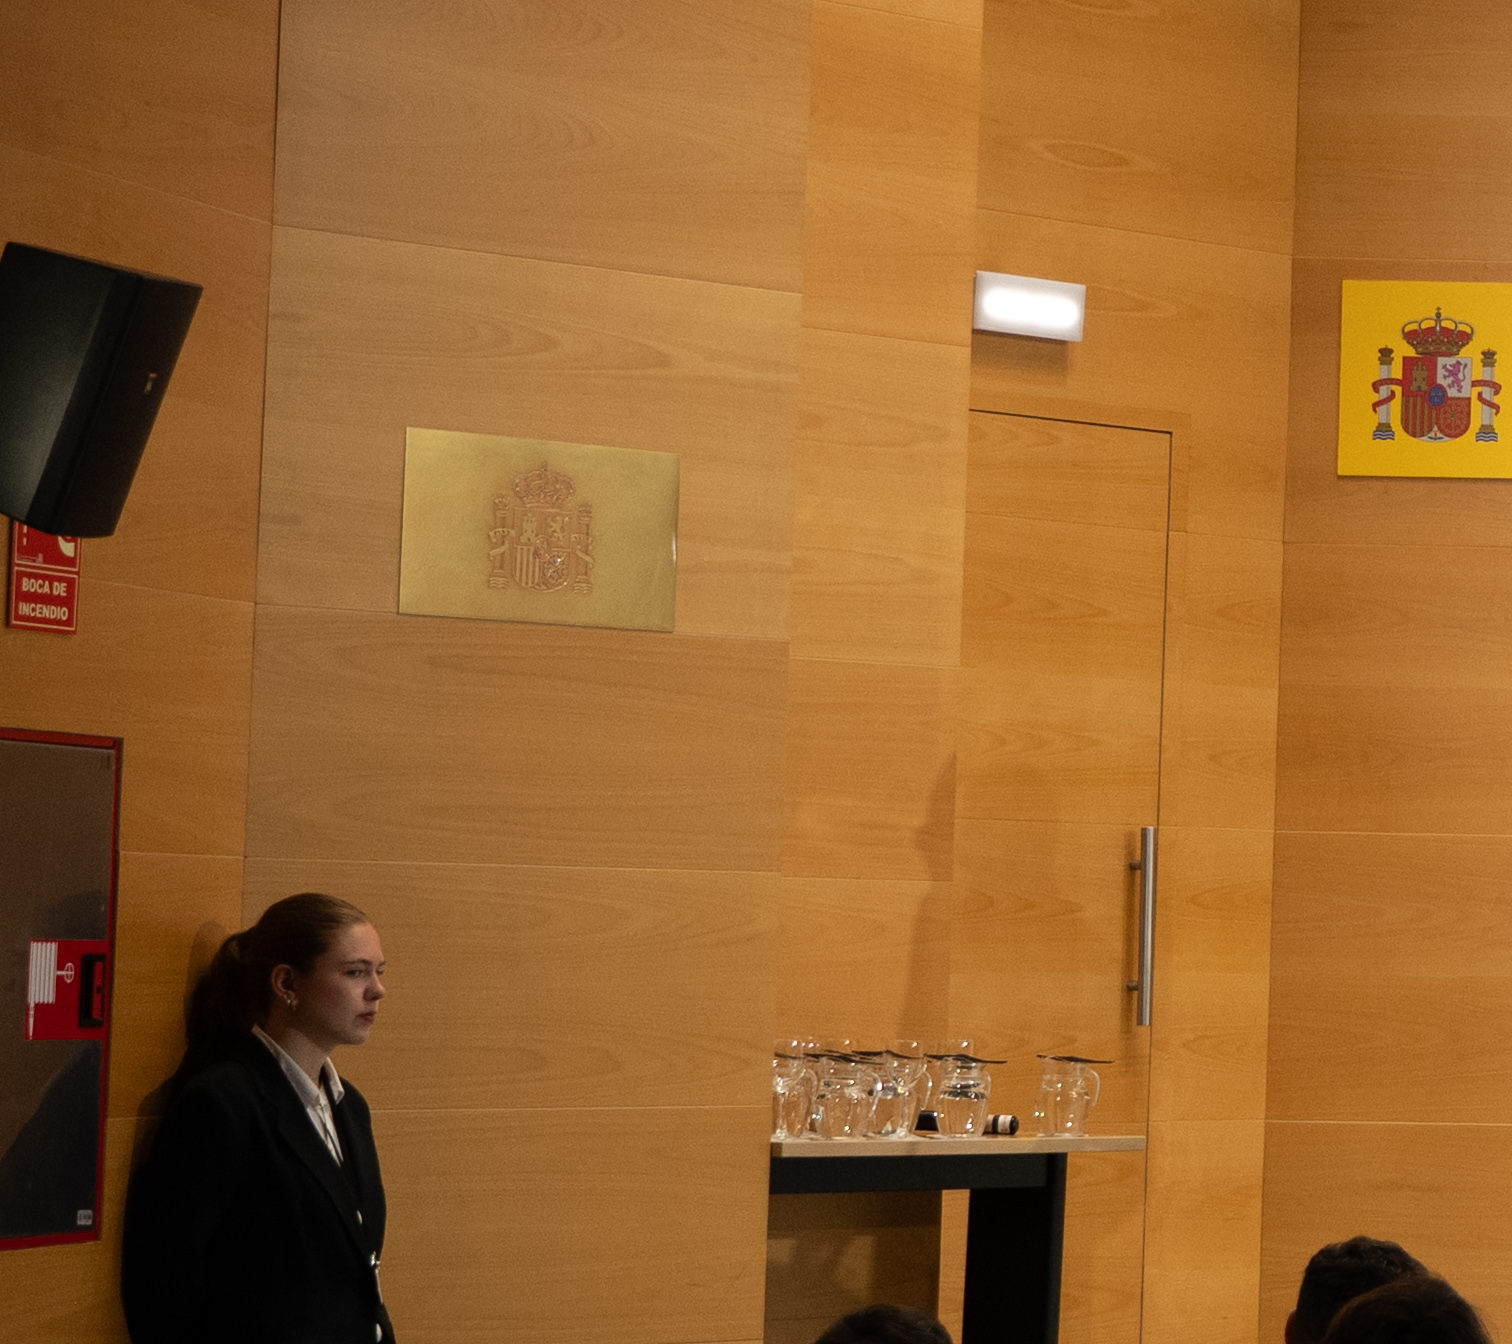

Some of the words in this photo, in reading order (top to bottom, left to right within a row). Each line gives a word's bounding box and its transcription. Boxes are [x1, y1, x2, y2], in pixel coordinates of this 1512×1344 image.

[22, 578, 50, 594] BOCA
[53, 582, 67, 596] DE
[19, 602, 68, 620] INCENDIO
